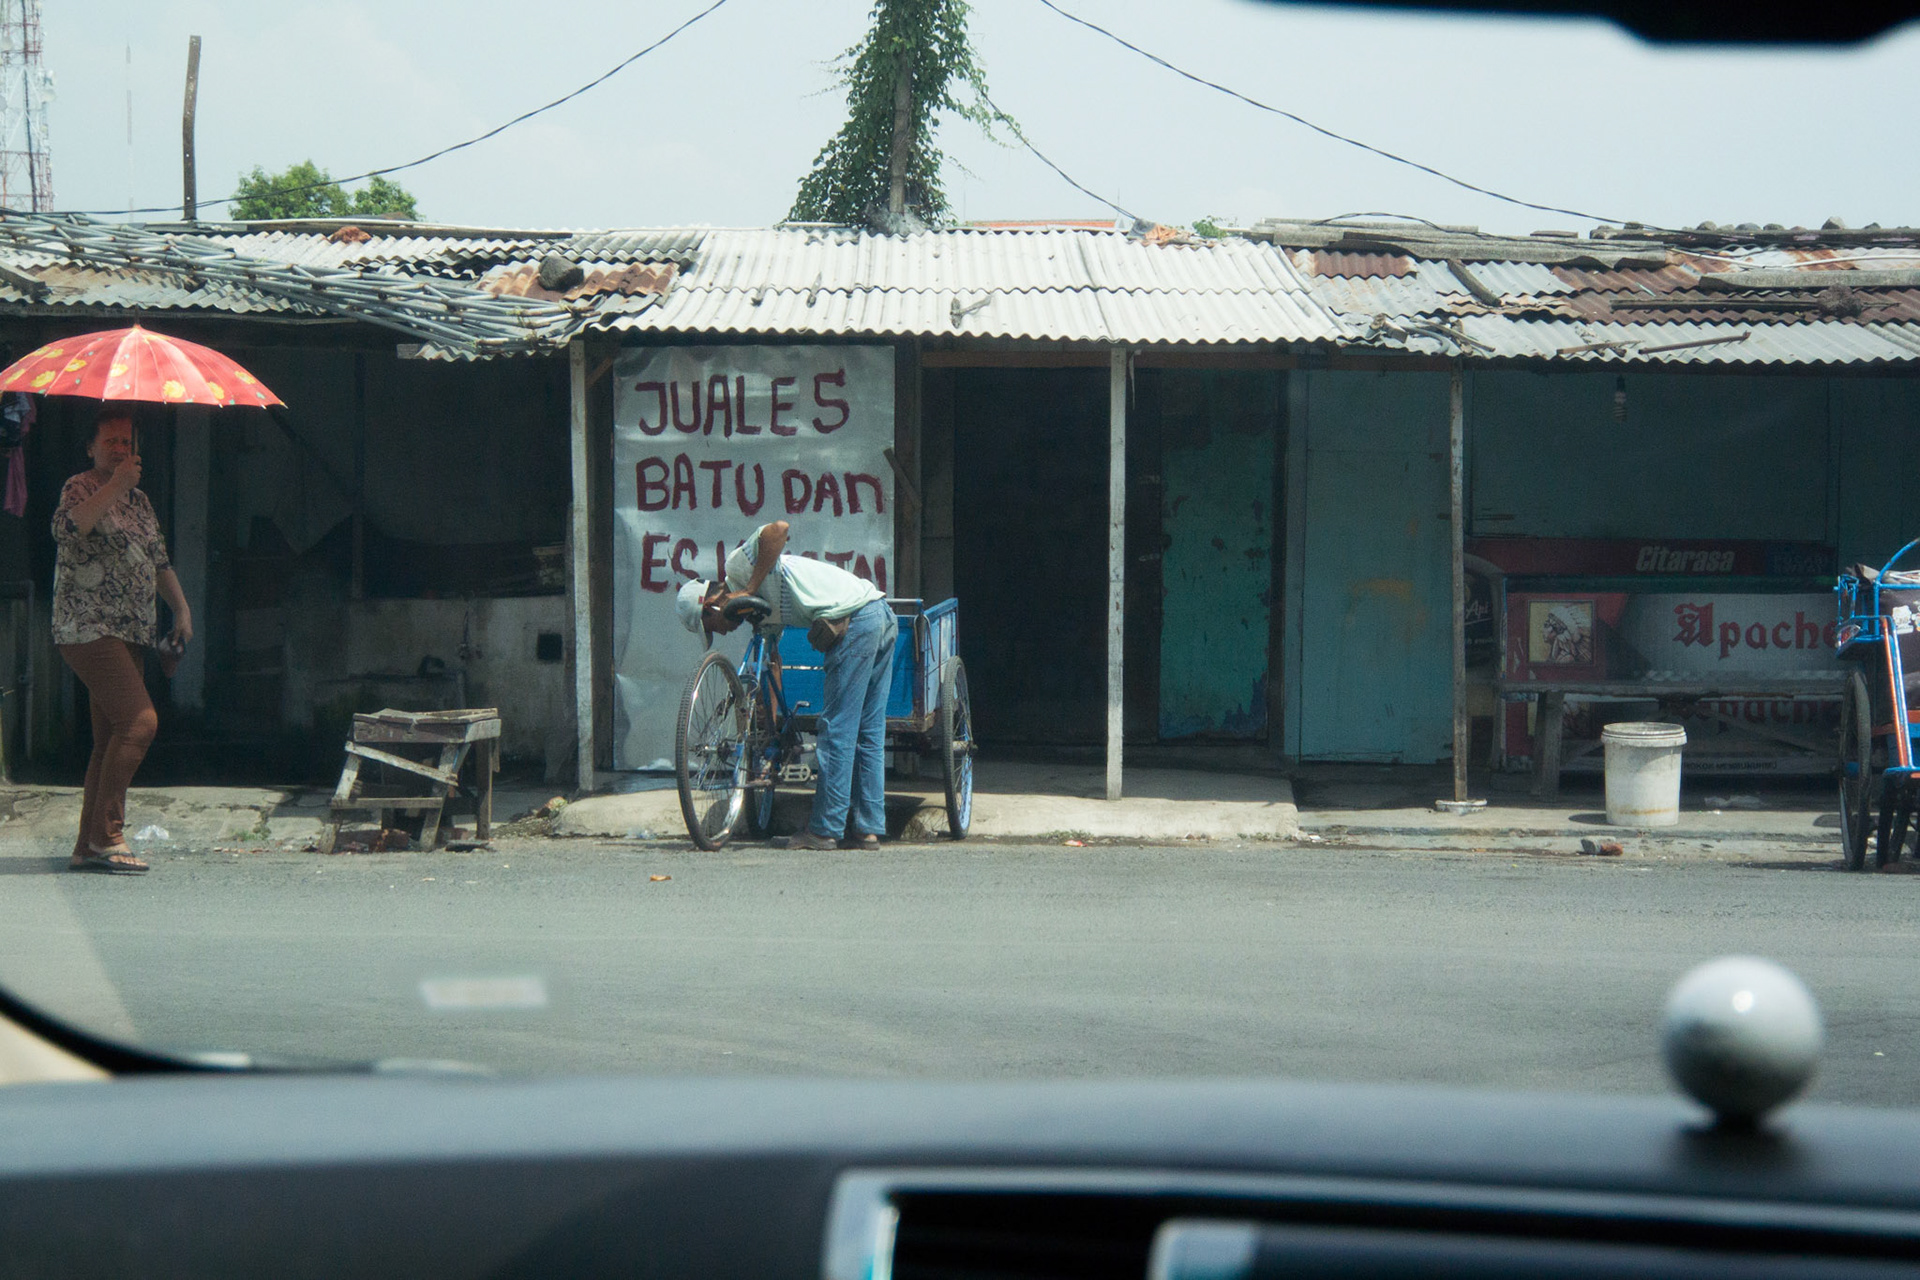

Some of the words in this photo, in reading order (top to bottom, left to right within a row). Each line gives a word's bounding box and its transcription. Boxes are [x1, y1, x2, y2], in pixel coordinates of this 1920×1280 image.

[635, 452, 765, 517] BATU
[640, 530, 700, 594] ES
[1635, 545, 1736, 573] Citarasa
